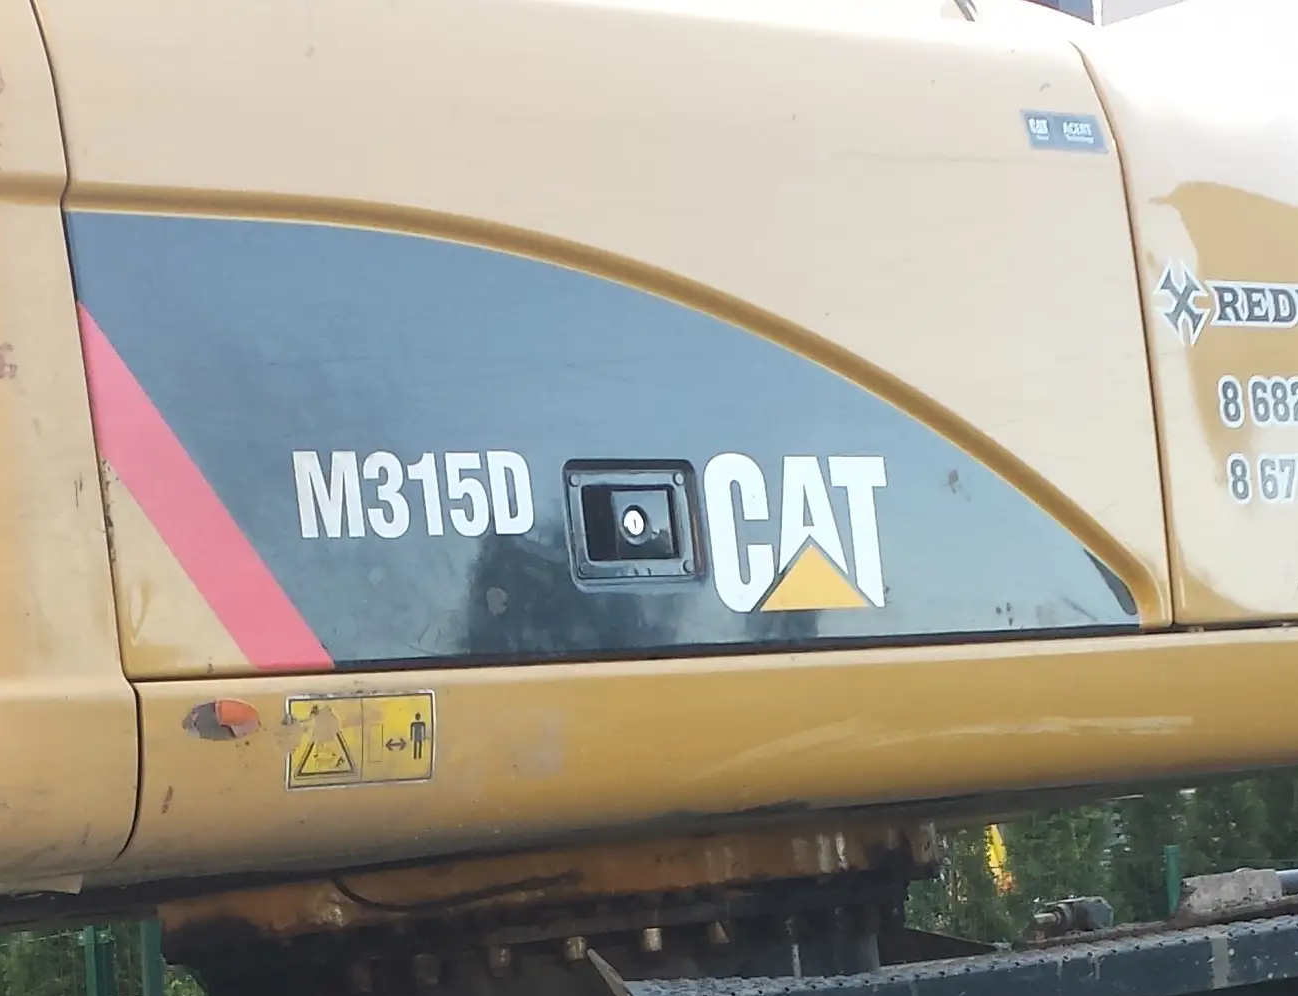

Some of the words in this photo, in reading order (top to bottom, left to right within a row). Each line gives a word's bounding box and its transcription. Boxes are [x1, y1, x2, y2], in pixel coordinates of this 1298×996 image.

[1221, 379, 1243, 424] 8
[292, 450, 535, 539] M315D
[1229, 457, 1251, 502] 8
[704, 452, 888, 614] CAT
